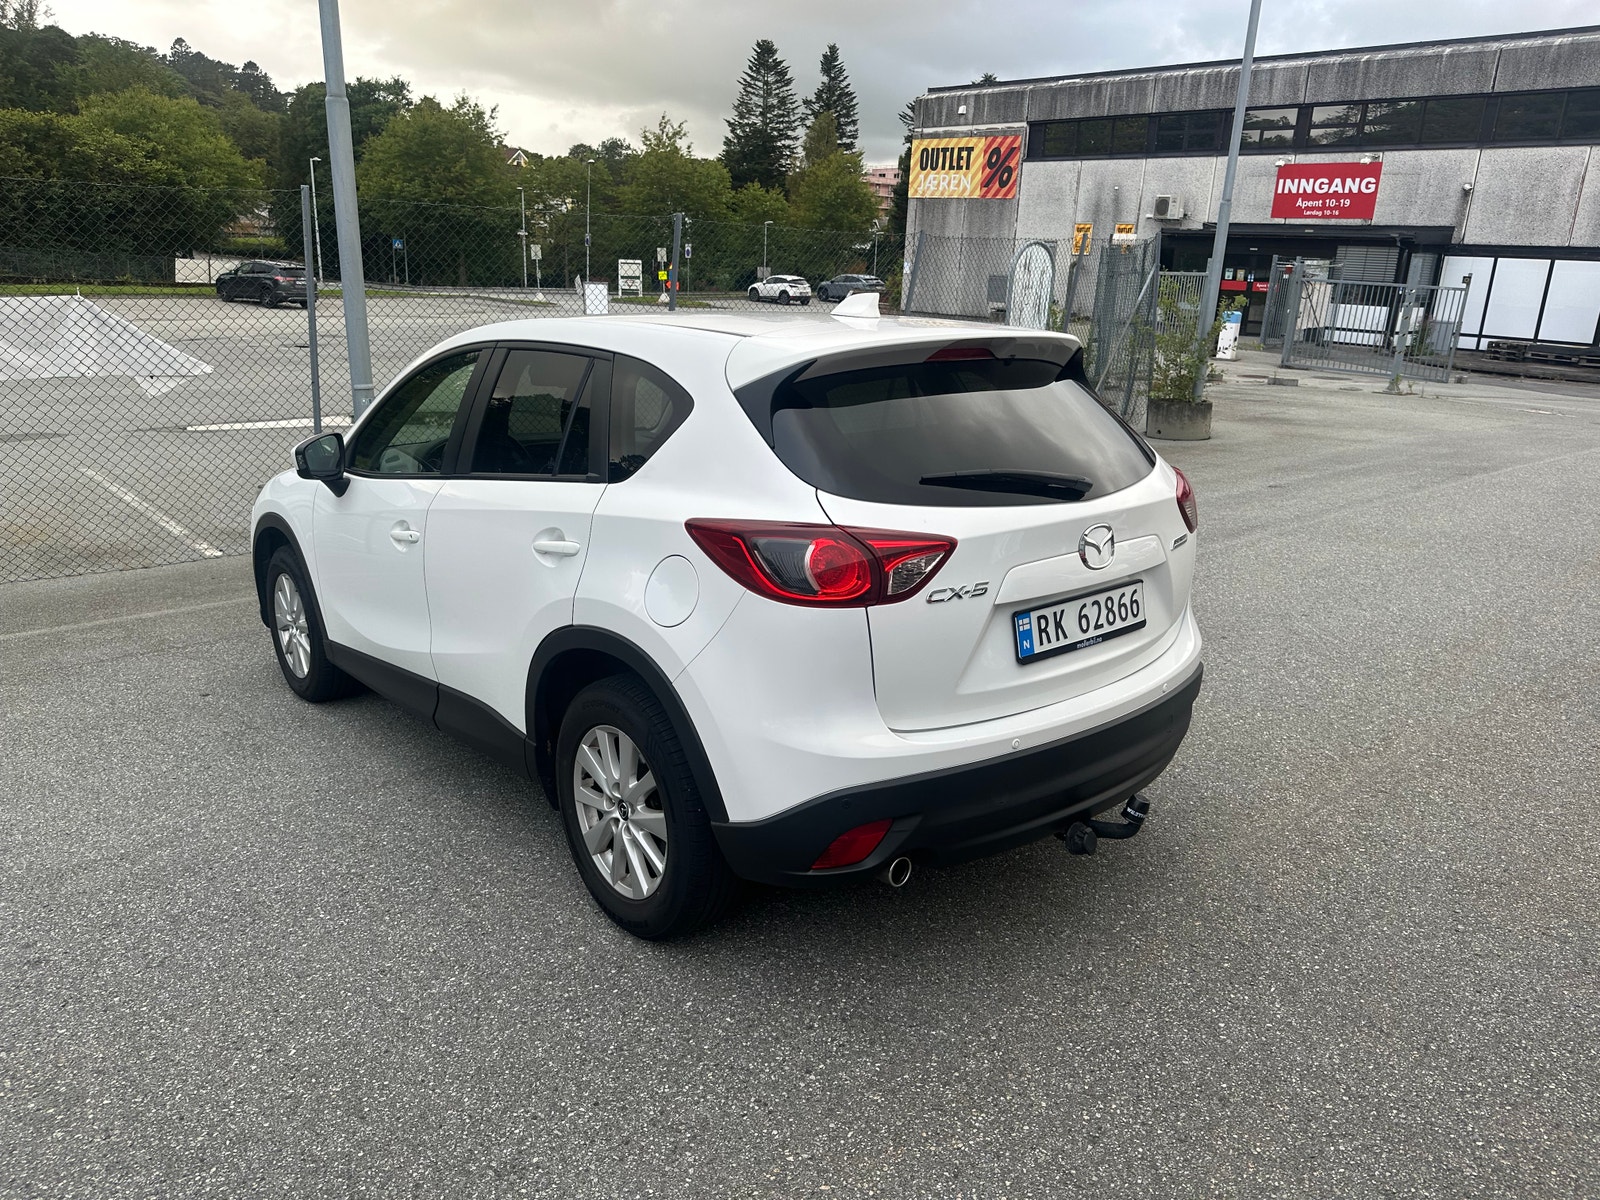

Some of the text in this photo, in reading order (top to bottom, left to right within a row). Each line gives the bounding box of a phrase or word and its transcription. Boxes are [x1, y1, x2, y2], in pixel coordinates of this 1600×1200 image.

[920, 147, 974, 171] OUTLET
[984, 147, 1017, 188] %
[917, 173, 972, 195] JÆREN
[1277, 177, 1377, 194] INNGANG
[1296, 197, 1351, 209] Åpent 10-19
[926, 580, 990, 604] CX-5
[1036, 588, 1140, 647] RK 62866
[1023, 639, 1031, 650] N
